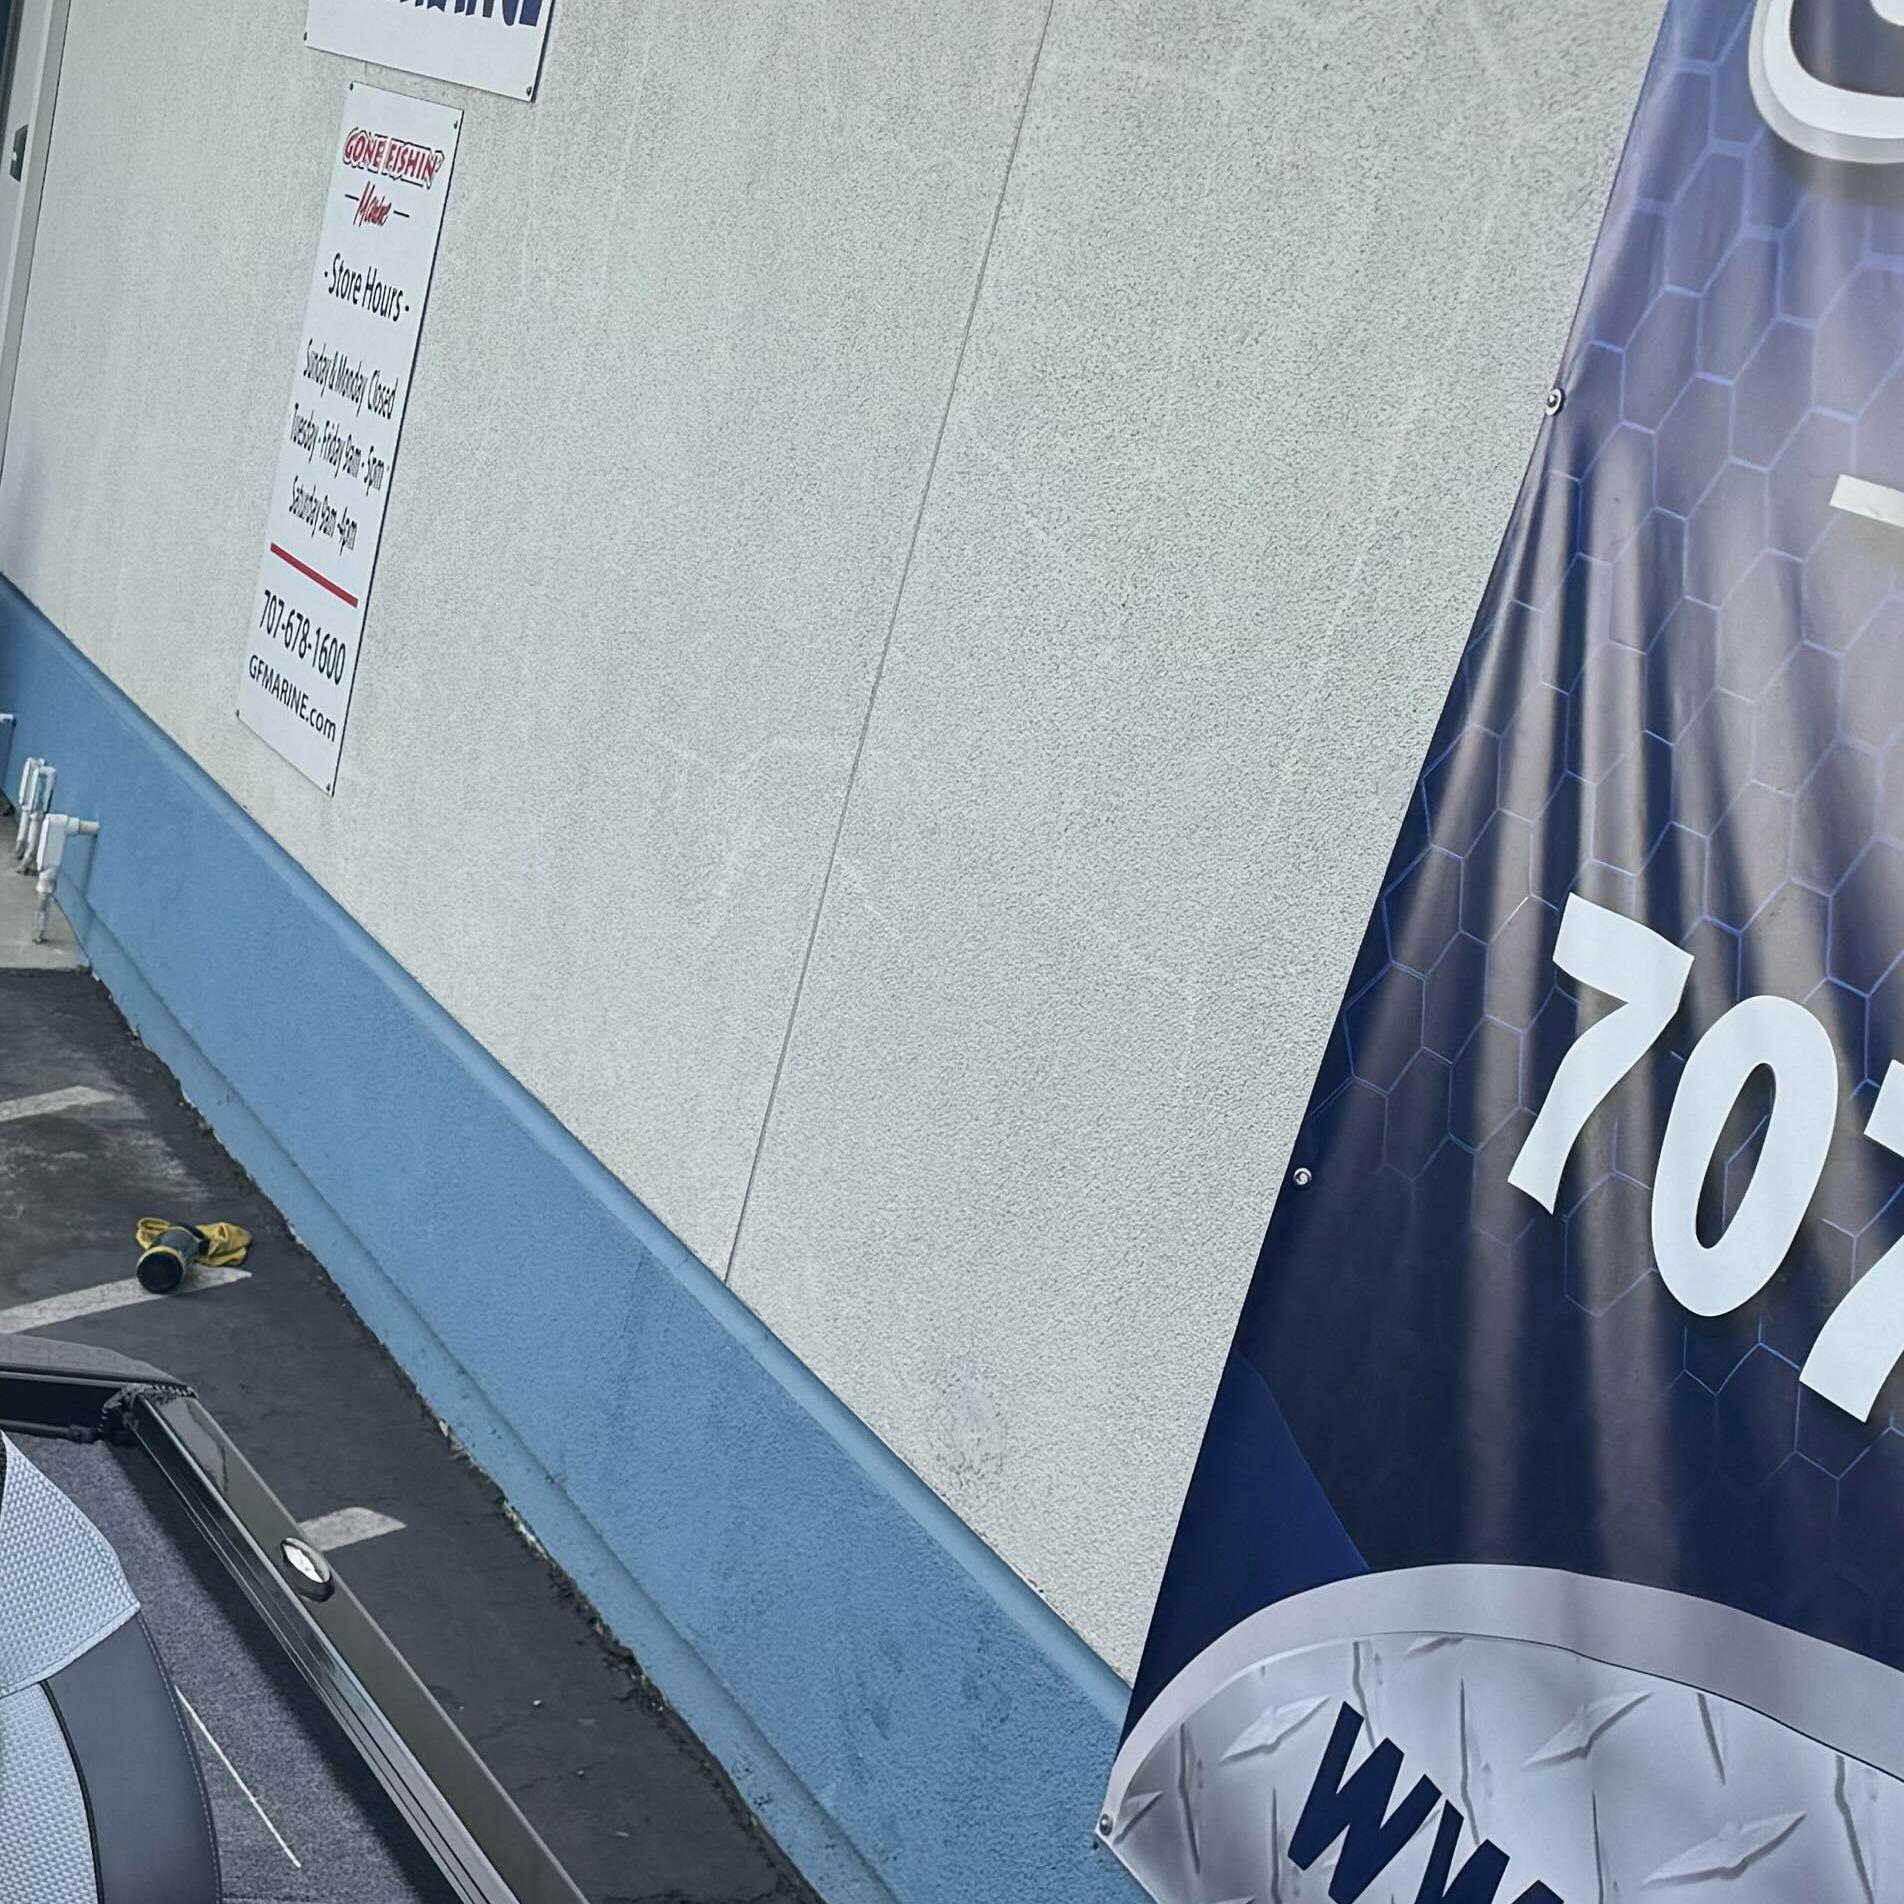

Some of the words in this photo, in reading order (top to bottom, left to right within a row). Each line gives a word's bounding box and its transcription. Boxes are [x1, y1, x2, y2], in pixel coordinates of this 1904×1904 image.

[343, 127, 386, 176] GONE
[328, 252, 362, 306] Store
[362, 266, 404, 322] Hours
[303, 338, 333, 398] Sunday
[335, 353, 368, 417] Monday
[367, 370, 398, 420] Closed
[291, 402, 320, 463] Tuesday
[320, 420, 346, 479] Friday
[289, 475, 323, 538] Saturday
[260, 589, 347, 686] 707-678-1600
[248, 654, 337, 743] GFMARINE.com
